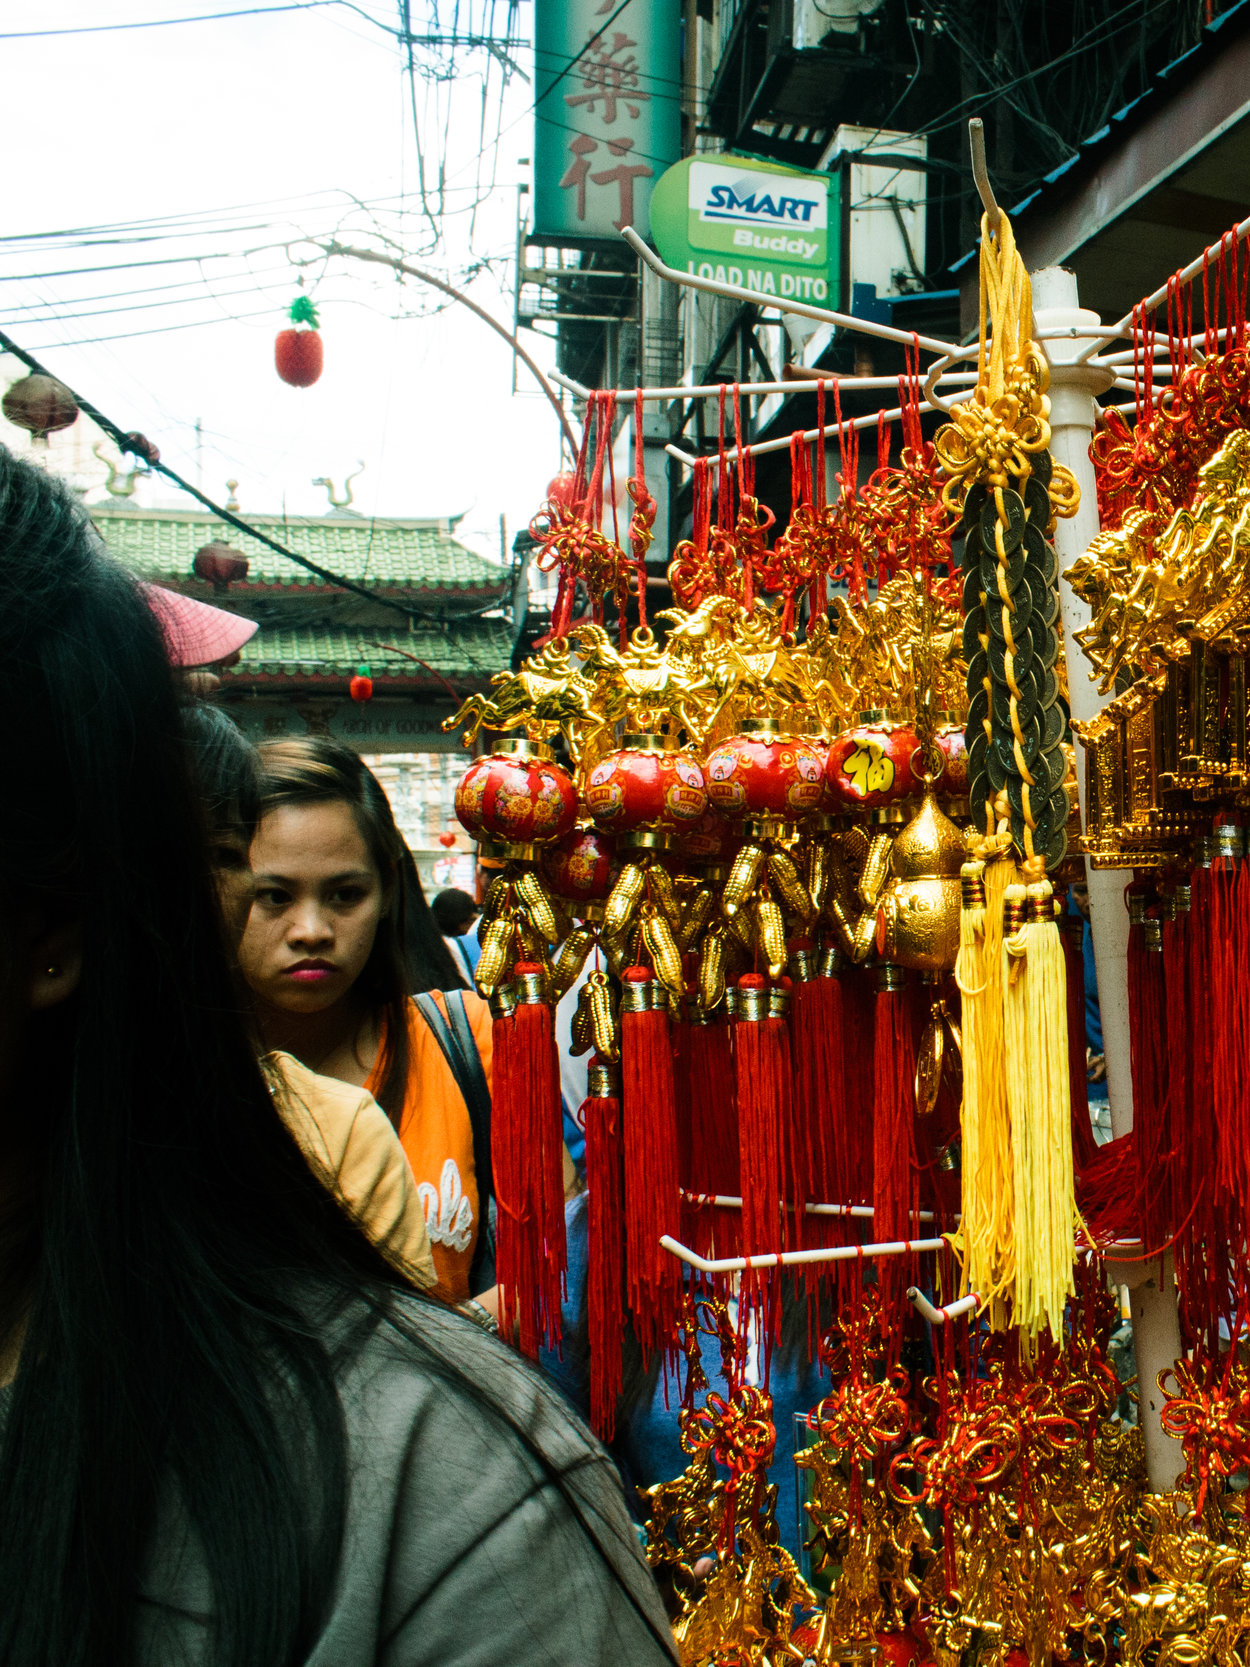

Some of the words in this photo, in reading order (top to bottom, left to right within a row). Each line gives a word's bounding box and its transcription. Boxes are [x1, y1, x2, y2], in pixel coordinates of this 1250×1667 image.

[558, 0, 655, 231] 藥行
[706, 183, 820, 224] SMART
[732, 229, 820, 260] Buddy
[747, 269, 777, 296] NA
[780, 273, 828, 301] DITO
[842, 736, 895, 797] 福
